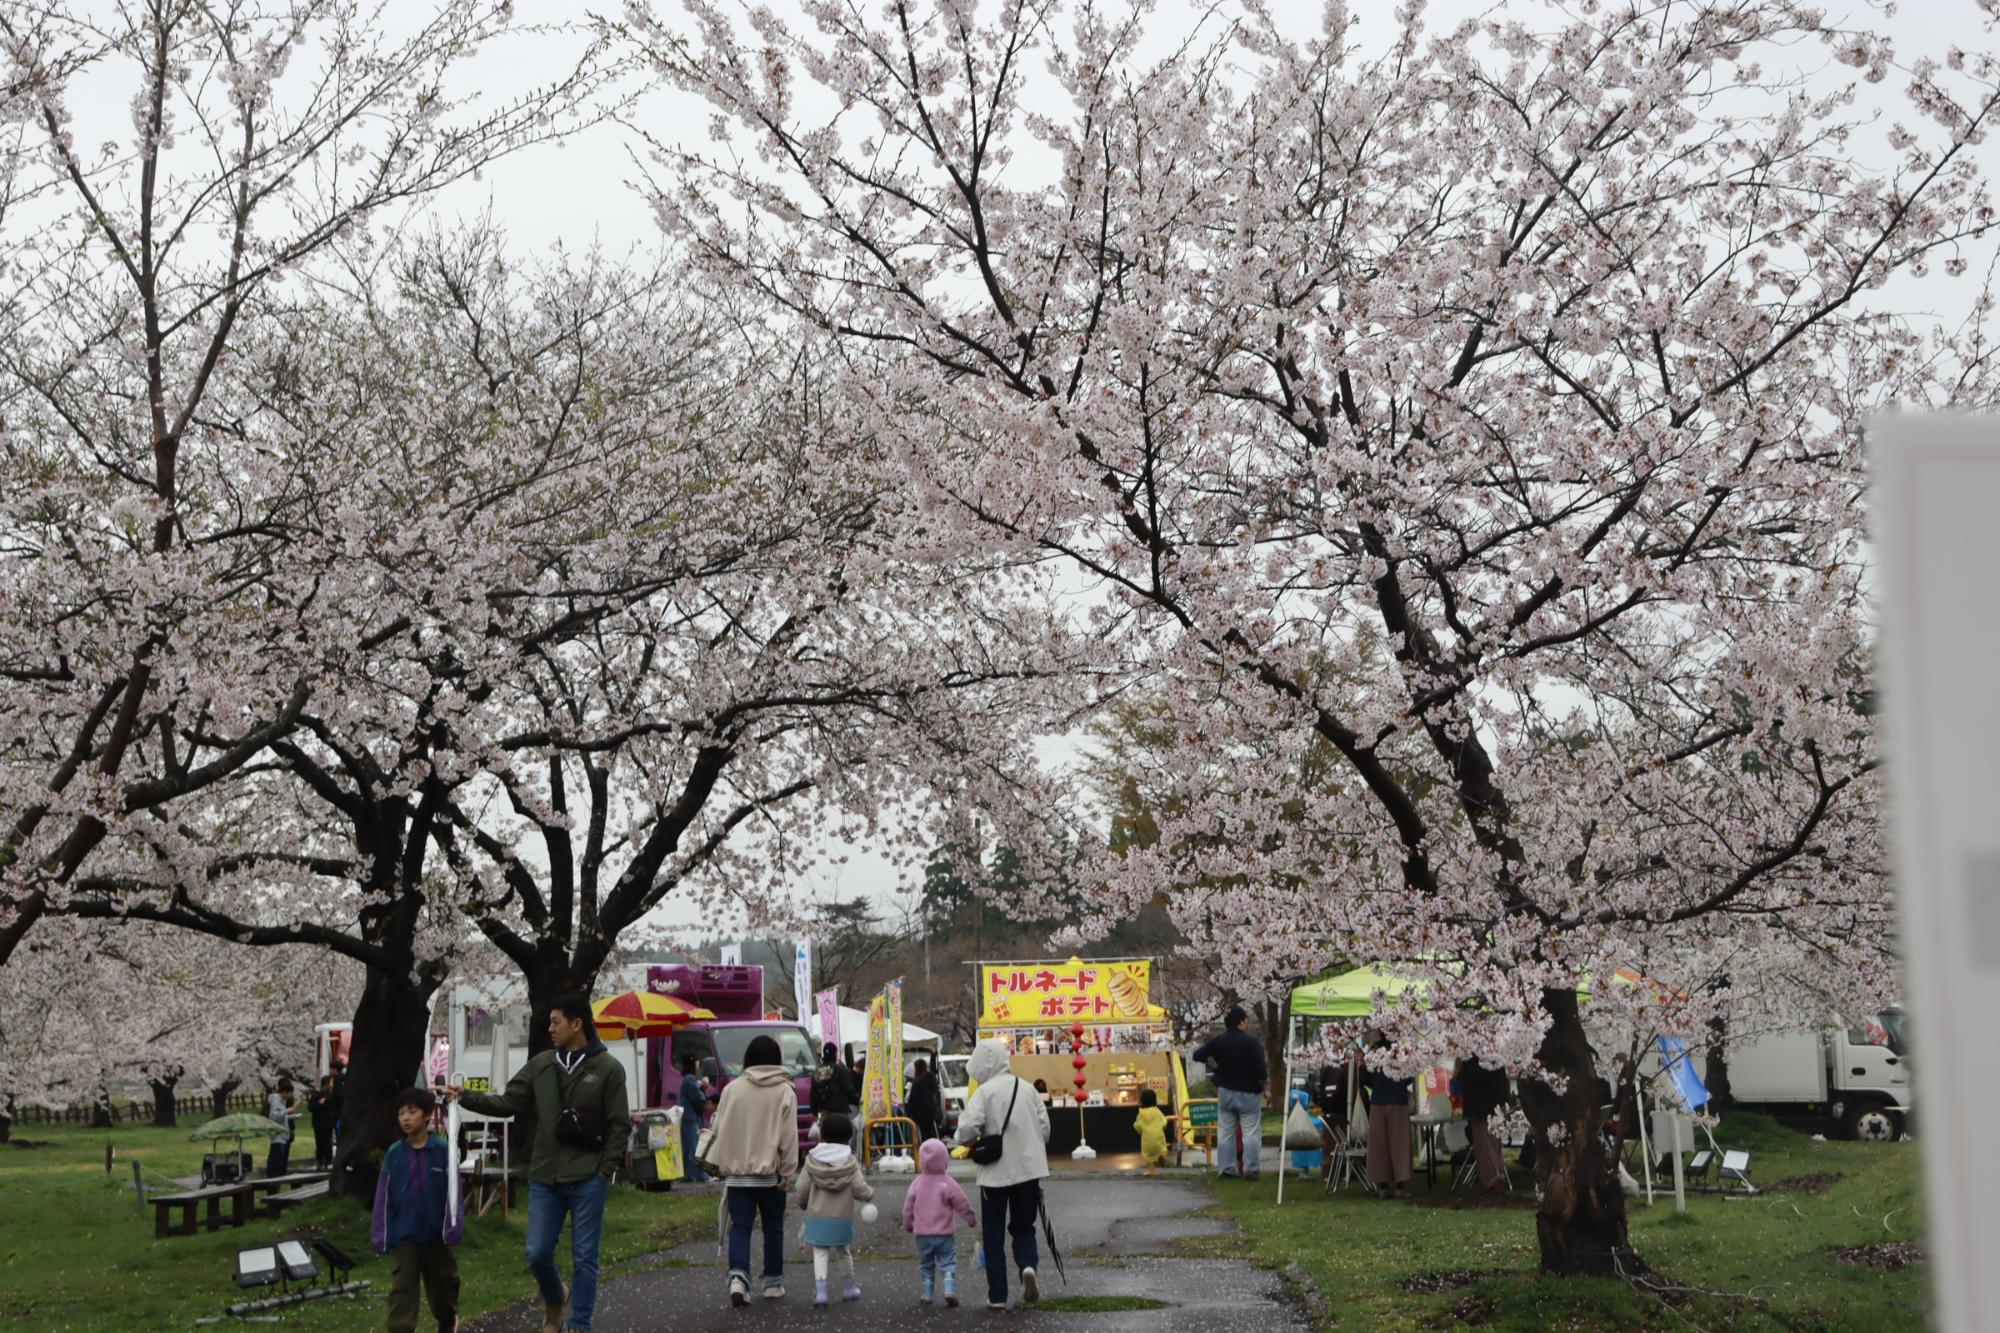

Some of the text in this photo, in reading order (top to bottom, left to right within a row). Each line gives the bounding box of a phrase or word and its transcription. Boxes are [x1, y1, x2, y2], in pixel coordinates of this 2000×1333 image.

[990, 969, 1096, 993] トルネード
[1040, 995, 1111, 1017] ポテト
